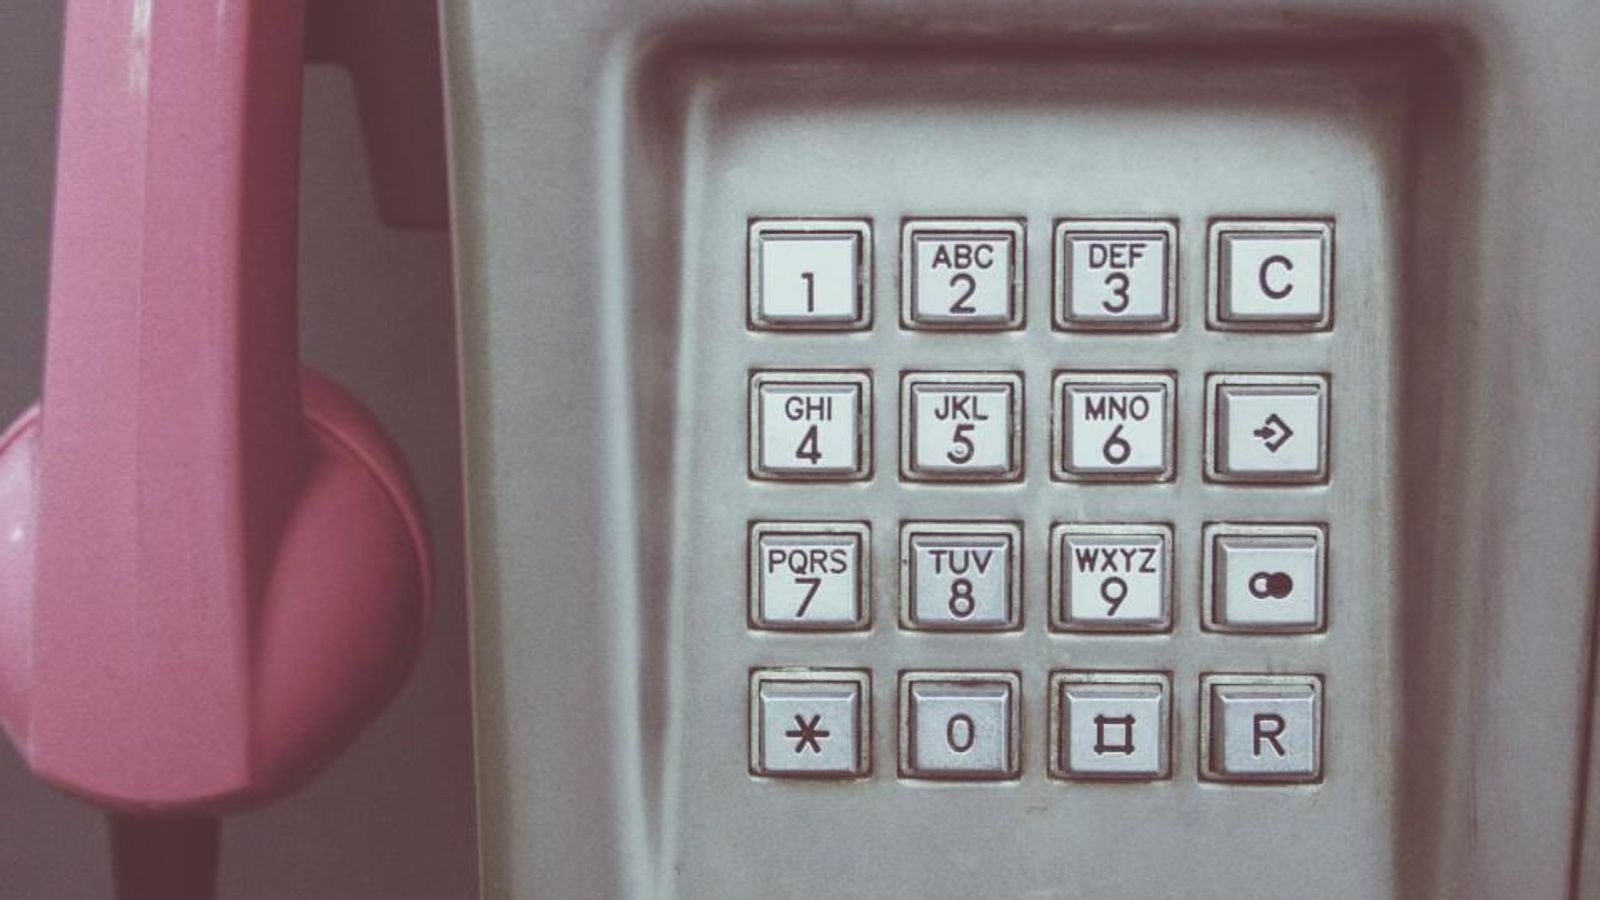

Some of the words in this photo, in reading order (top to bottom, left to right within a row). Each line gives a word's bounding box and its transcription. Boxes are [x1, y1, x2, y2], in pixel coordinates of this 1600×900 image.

[931, 243, 994, 270] ABC
[1088, 243, 1147, 270] DEF
[801, 272, 814, 313] 1
[949, 272, 977, 314] 2
[1102, 272, 1130, 314] 3
[1258, 255, 1294, 300] C
[784, 396, 833, 422] GHI
[934, 396, 988, 421] JKL
[1085, 396, 1150, 421] MNO
[795, 425, 822, 465] 4
[946, 424, 975, 465] 5
[1103, 424, 1132, 465] 6
[768, 549, 848, 575] PQRS
[928, 549, 994, 575] TUV
[1075, 547, 1157, 573] WXYZ
[794, 578, 822, 618] 7
[948, 578, 976, 618] 8
[1101, 577, 1128, 617] 9
[1254, 712, 1286, 756] R
